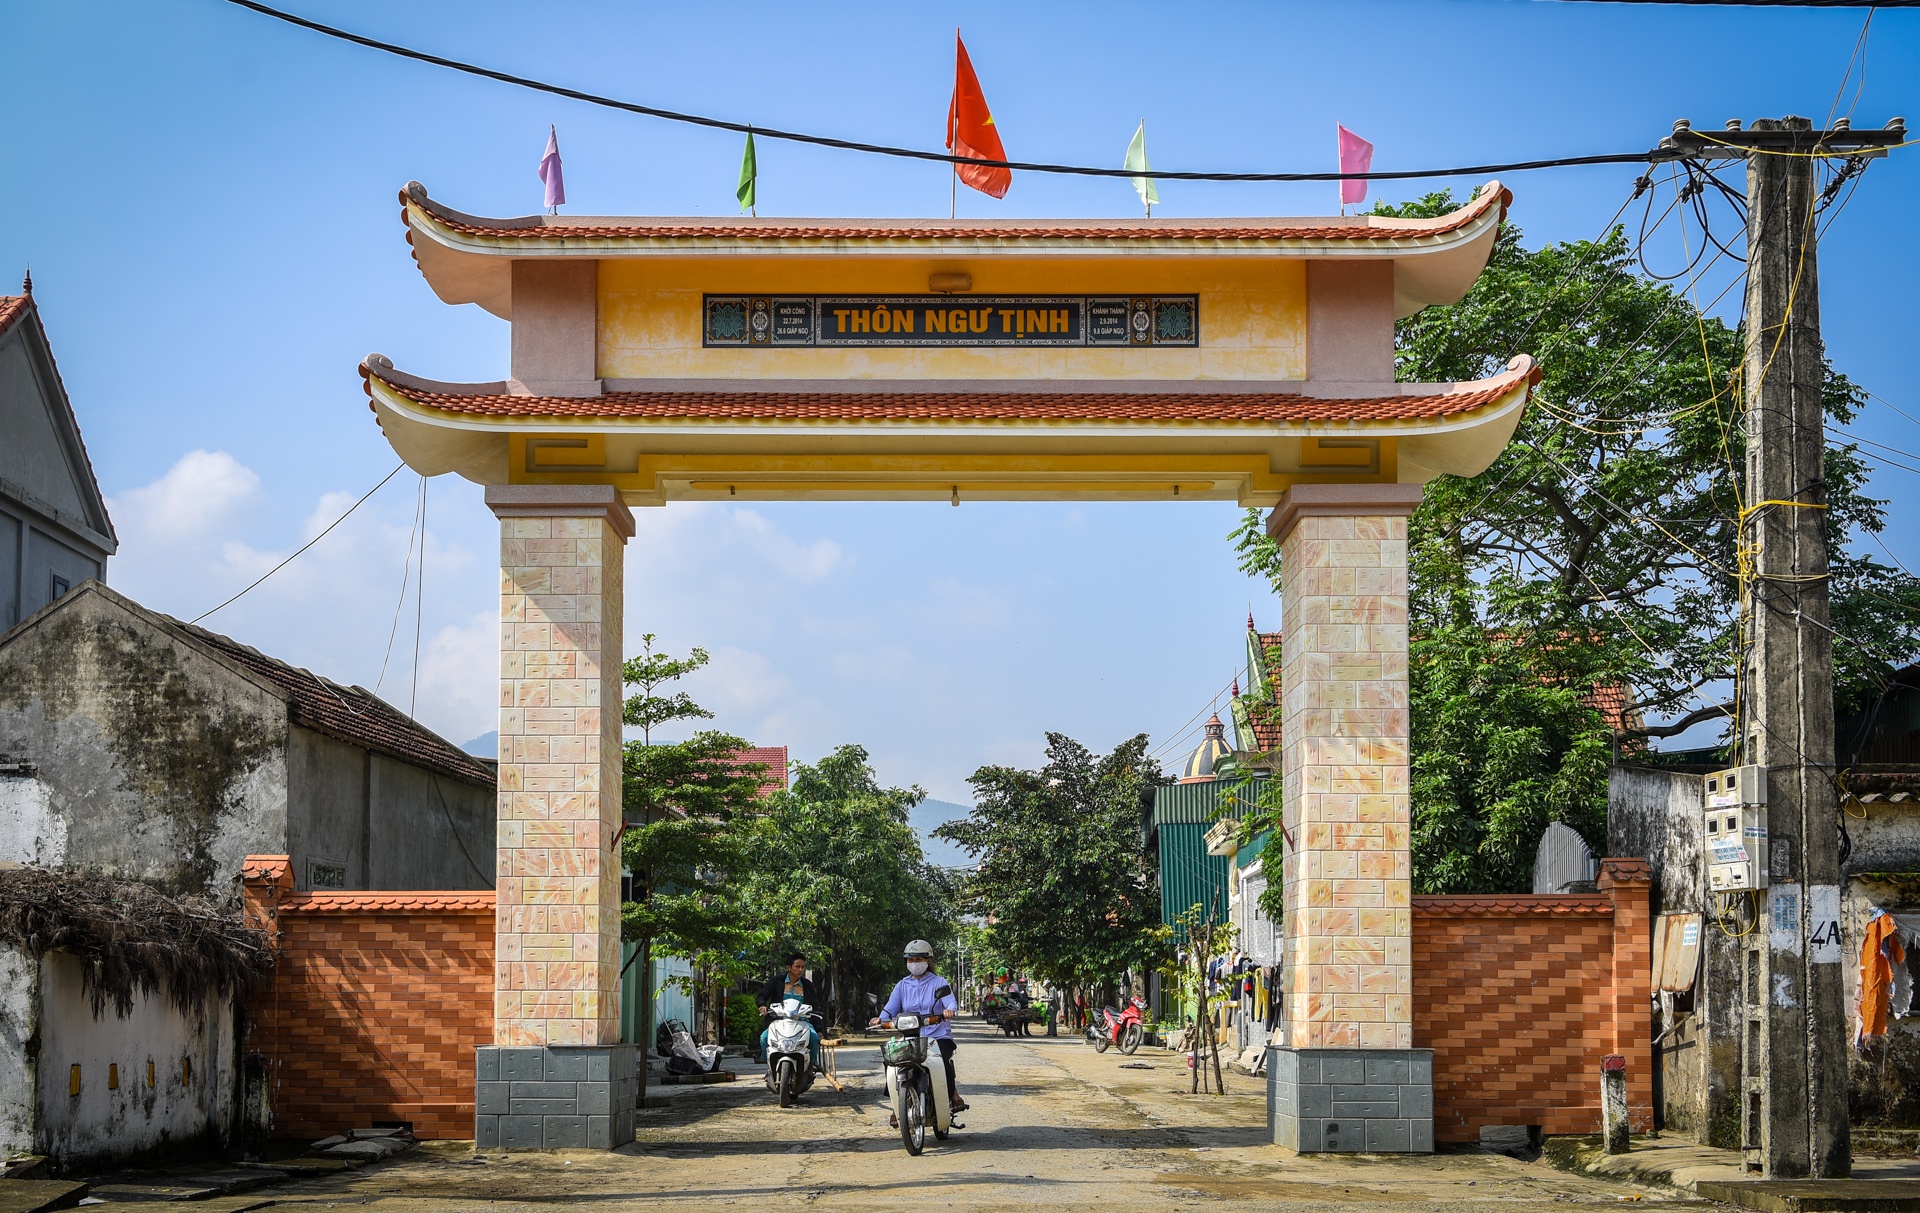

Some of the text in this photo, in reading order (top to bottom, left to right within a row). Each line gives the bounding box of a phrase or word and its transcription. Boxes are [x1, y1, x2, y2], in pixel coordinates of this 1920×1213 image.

[1109, 306, 1125, 314] THÀNH
[833, 305, 1069, 338] THÔN NGƯ TỊNH
[786, 326, 797, 334] GIÁP
[1100, 326, 1112, 334] GIÁP
[1810, 920, 1841, 950] 4A
